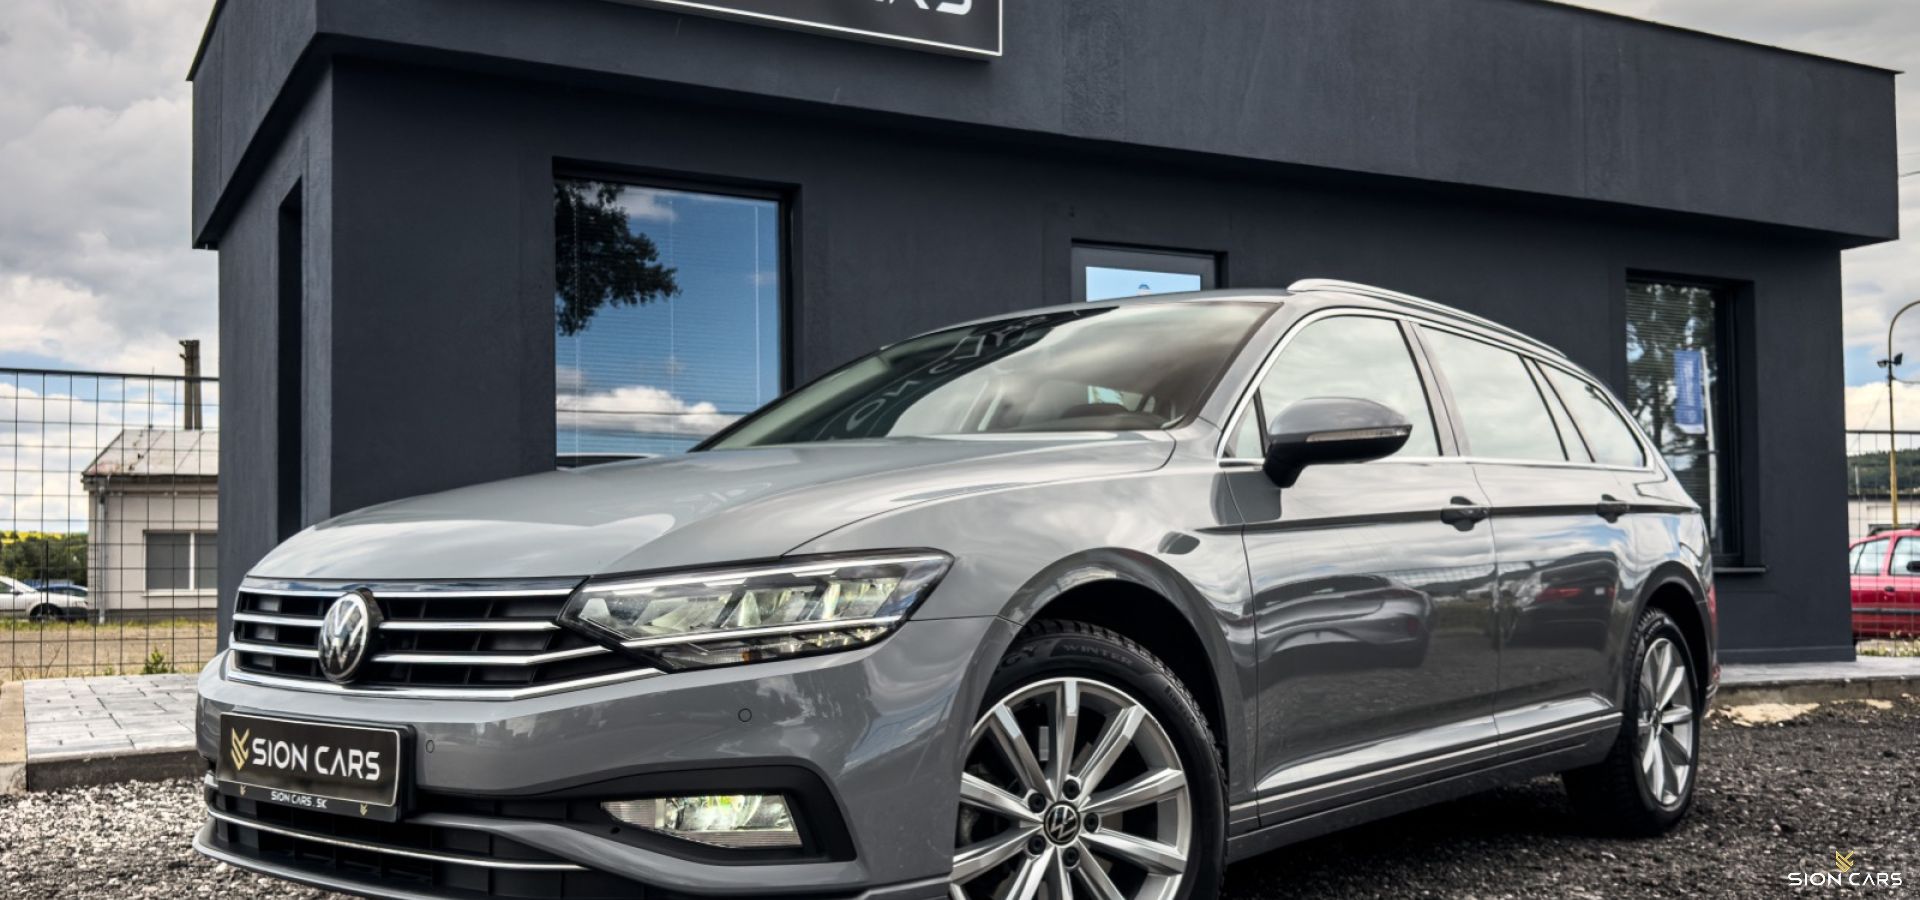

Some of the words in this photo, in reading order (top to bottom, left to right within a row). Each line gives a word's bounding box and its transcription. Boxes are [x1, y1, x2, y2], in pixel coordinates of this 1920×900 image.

[252, 738, 308, 772] SION
[314, 745, 381, 781] CARS
[271, 790, 290, 803] SION
